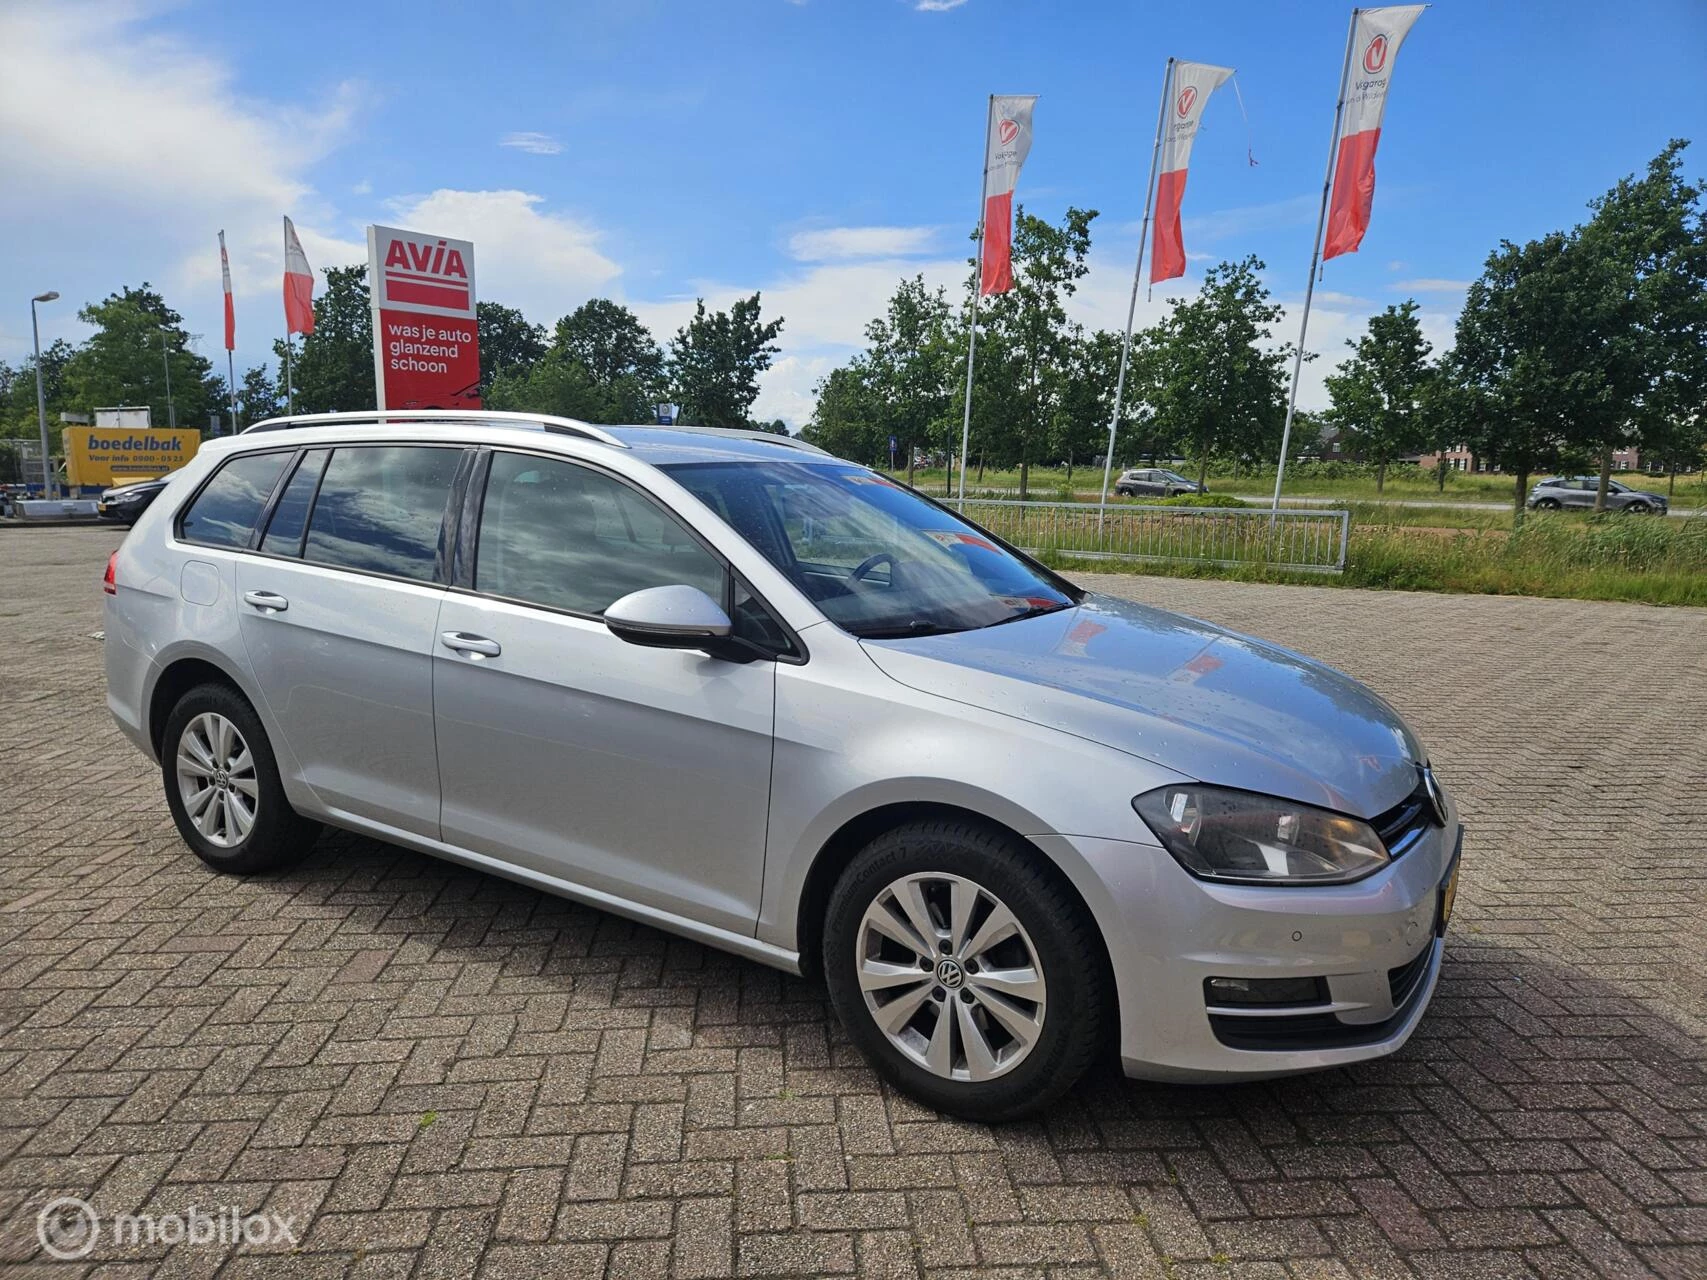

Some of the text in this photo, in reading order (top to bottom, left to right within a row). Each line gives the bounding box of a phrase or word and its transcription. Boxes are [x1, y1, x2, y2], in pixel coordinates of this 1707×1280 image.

[389, 324, 472, 343] was je auto
[390, 340, 459, 358] glanzend
[391, 357, 447, 373] schoon
[88, 435, 182, 451] boedelbak
[89, 454, 109, 462] Voor
[112, 454, 129, 462] info
